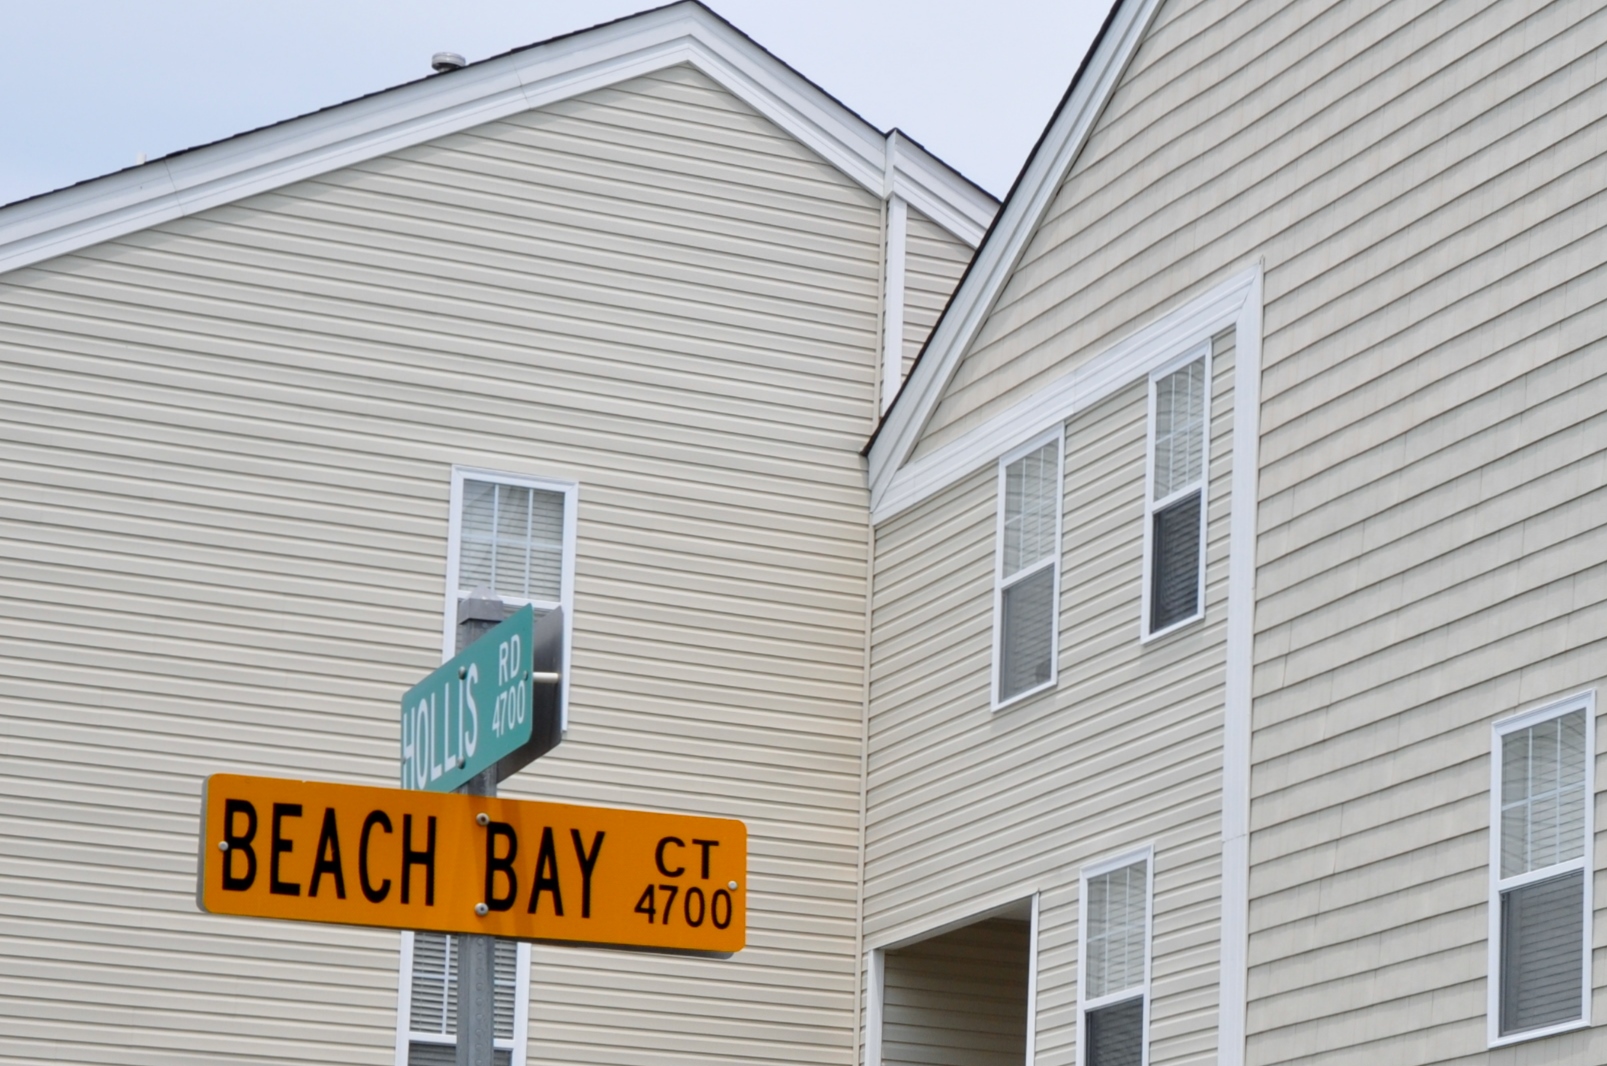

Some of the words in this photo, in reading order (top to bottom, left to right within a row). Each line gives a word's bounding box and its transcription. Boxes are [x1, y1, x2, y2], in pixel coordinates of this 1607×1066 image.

[403, 663, 479, 790] HOLLIS
[498, 633, 521, 687] RD
[491, 680, 526, 738] 4700
[221, 797, 437, 907] BEACH
[483, 821, 606, 919] BAY
[655, 836, 719, 880] CT
[635, 884, 733, 930] 4700
